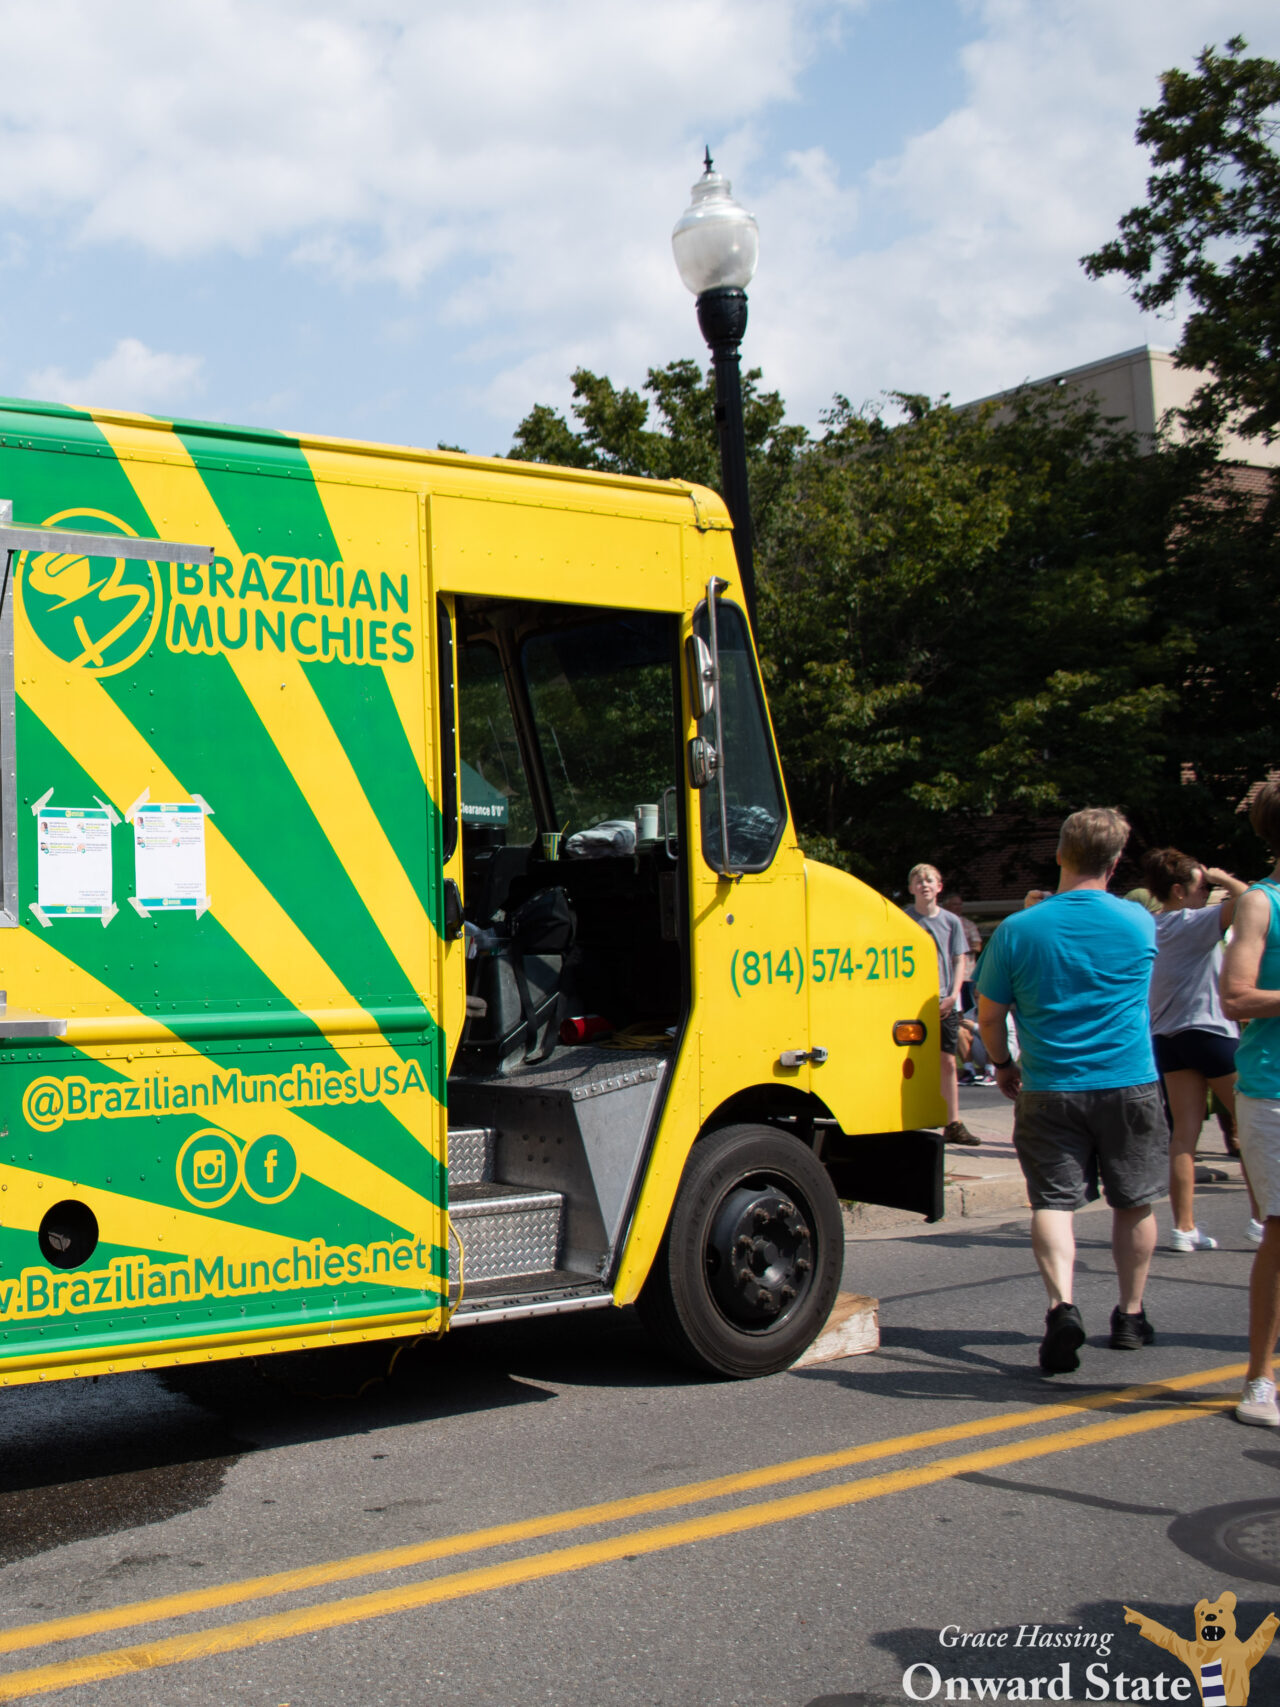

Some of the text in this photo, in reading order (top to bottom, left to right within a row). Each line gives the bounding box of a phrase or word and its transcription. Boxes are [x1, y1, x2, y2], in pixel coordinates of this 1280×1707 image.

[176, 557, 409, 614] BRAZILIAN
[172, 604, 415, 664] MUNCHIES
[730, 945, 916, 998] (814) 574-2115
[27, 1064, 425, 1126] @BrazilianMunchiesUSA
